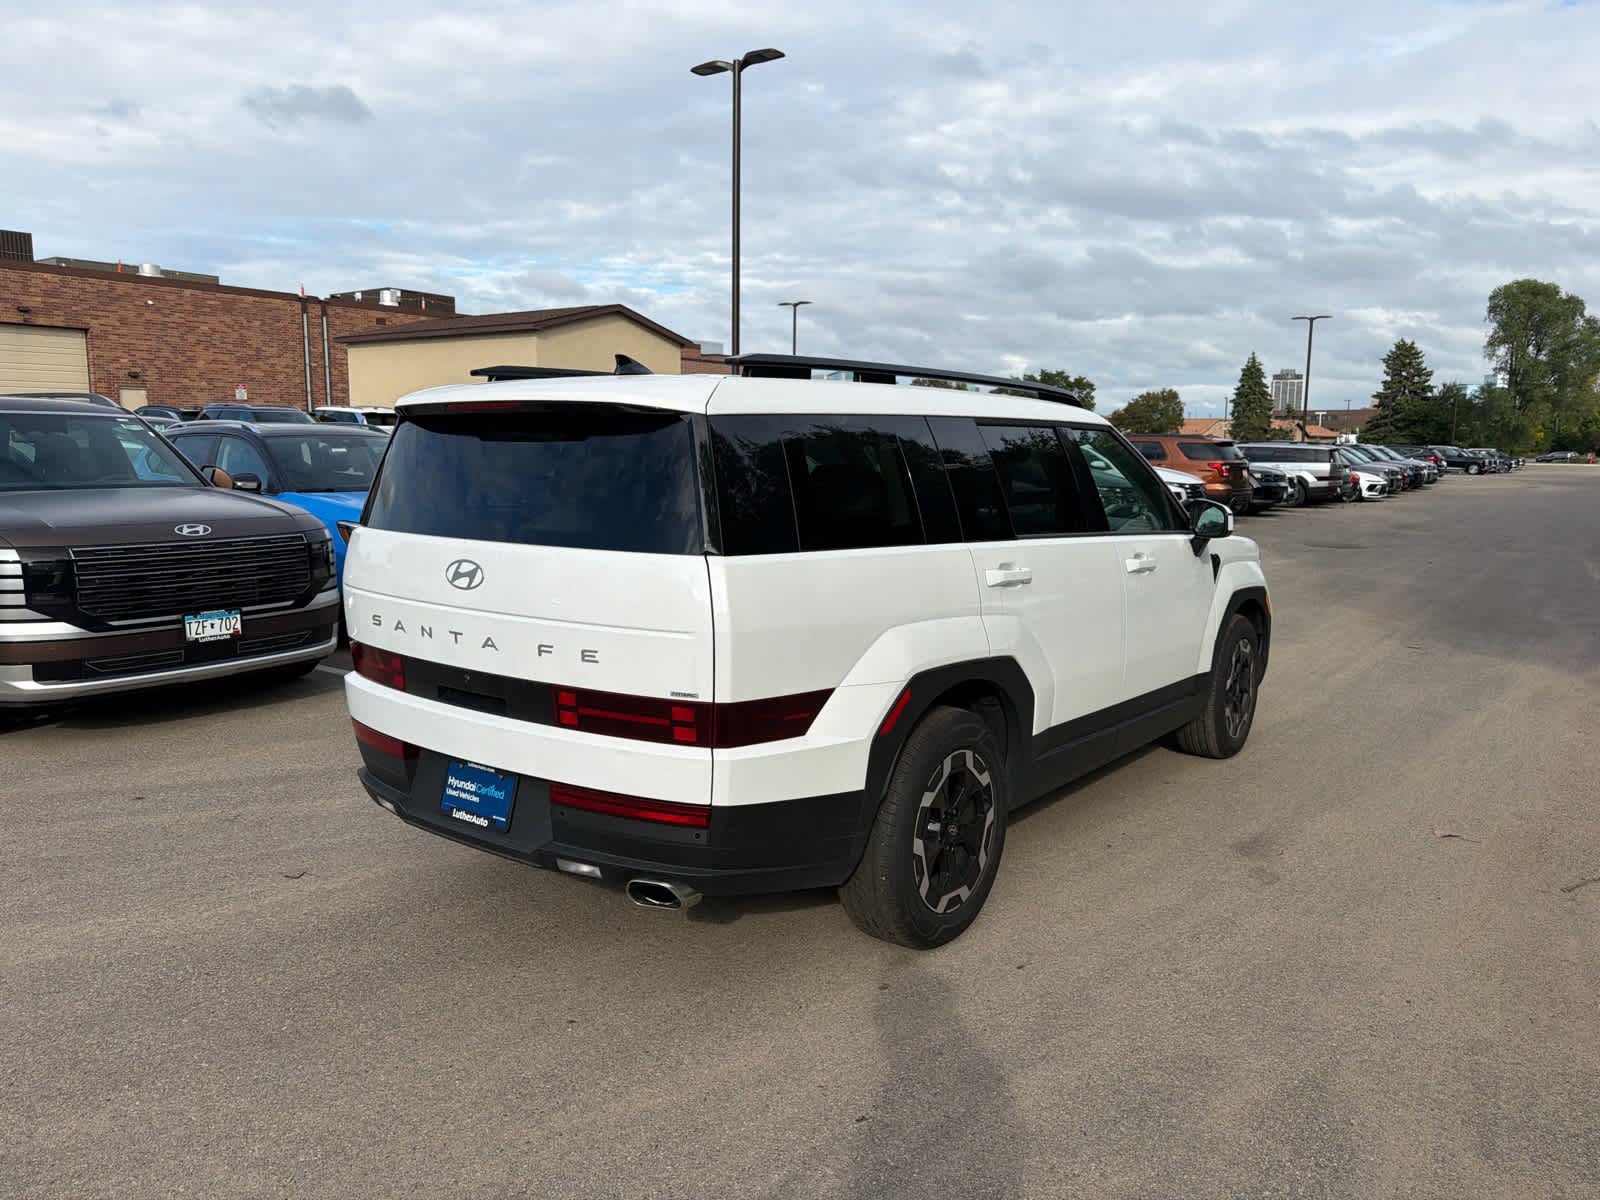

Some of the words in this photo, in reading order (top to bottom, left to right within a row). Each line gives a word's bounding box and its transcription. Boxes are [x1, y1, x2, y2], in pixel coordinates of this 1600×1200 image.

[187, 620, 208, 636] TZF
[218, 616, 239, 632] 702
[372, 614, 498, 651] SANTA
[538, 644, 599, 664] FE
[452, 808, 489, 827] LutherAuto
